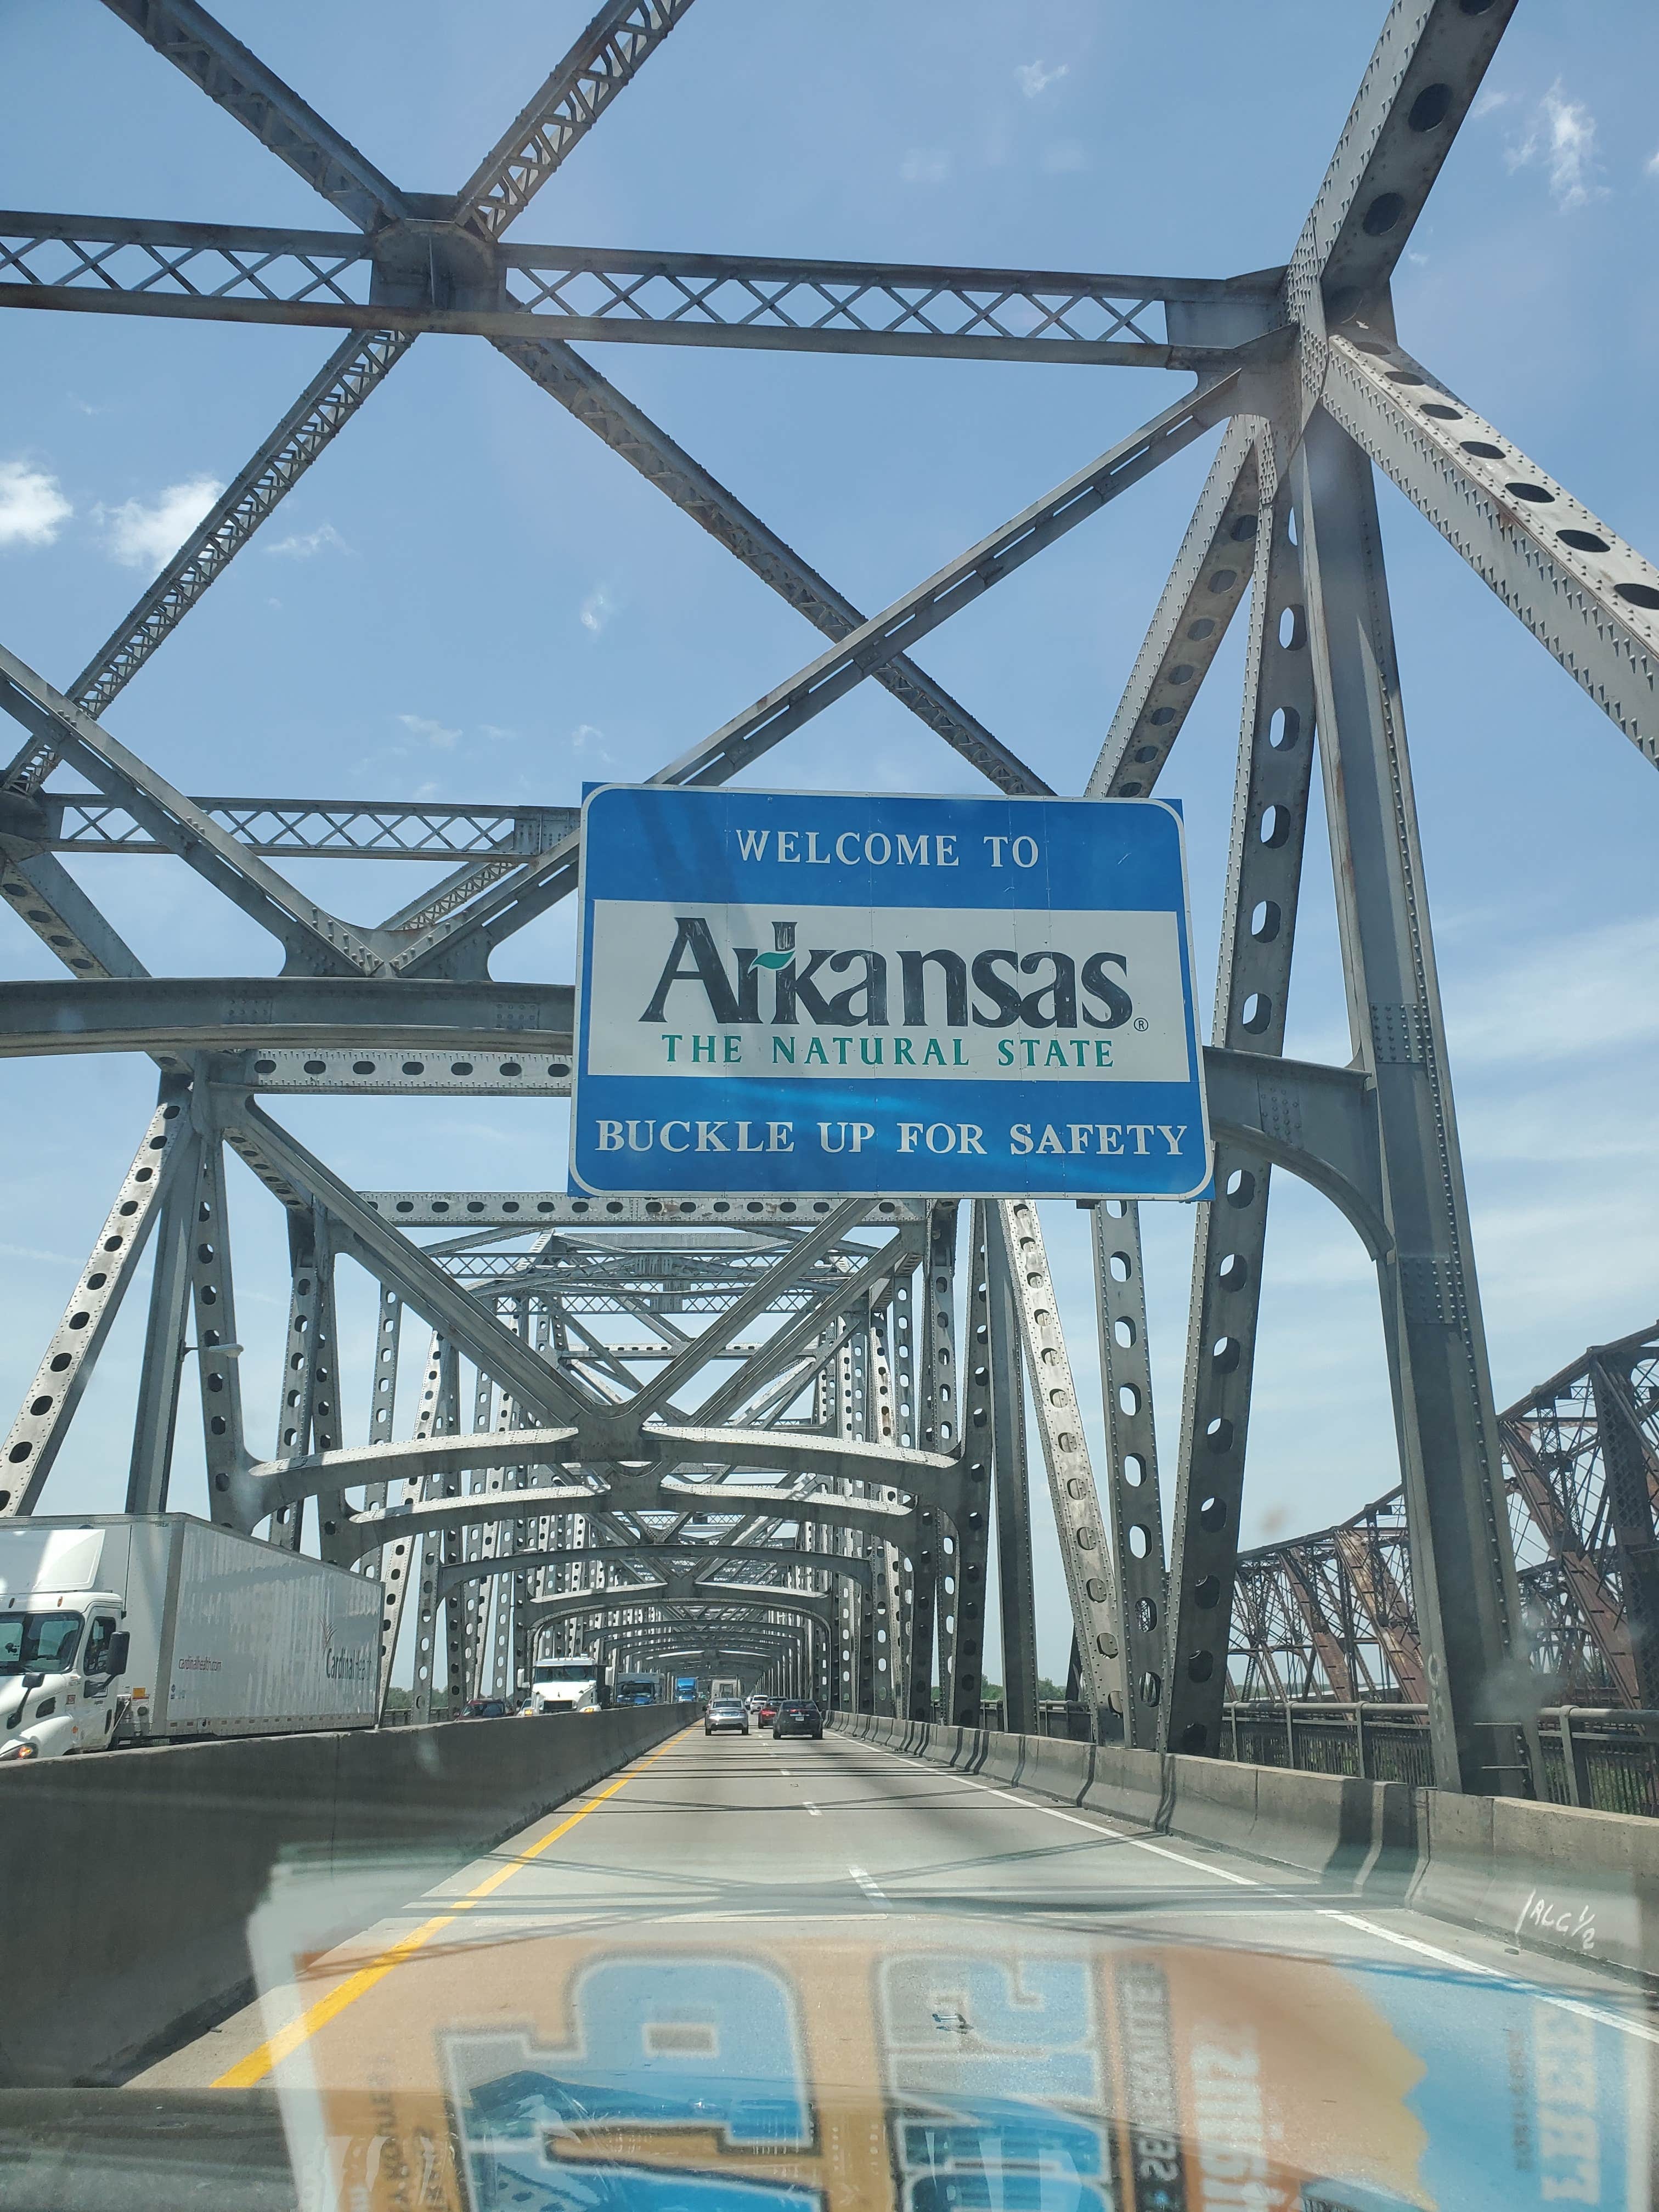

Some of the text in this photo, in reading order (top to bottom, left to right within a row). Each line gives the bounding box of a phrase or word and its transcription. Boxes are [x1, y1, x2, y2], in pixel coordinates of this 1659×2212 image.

[736, 829, 1039, 868] WELCOME TO
[638, 917, 1133, 1030] Arkansas
[662, 1034, 1114, 1068] THE NATURAL STATE
[595, 1119, 1188, 1156] BUCKLE UP FOR SAFETY
[326, 1647, 356, 1680] Cardinal
